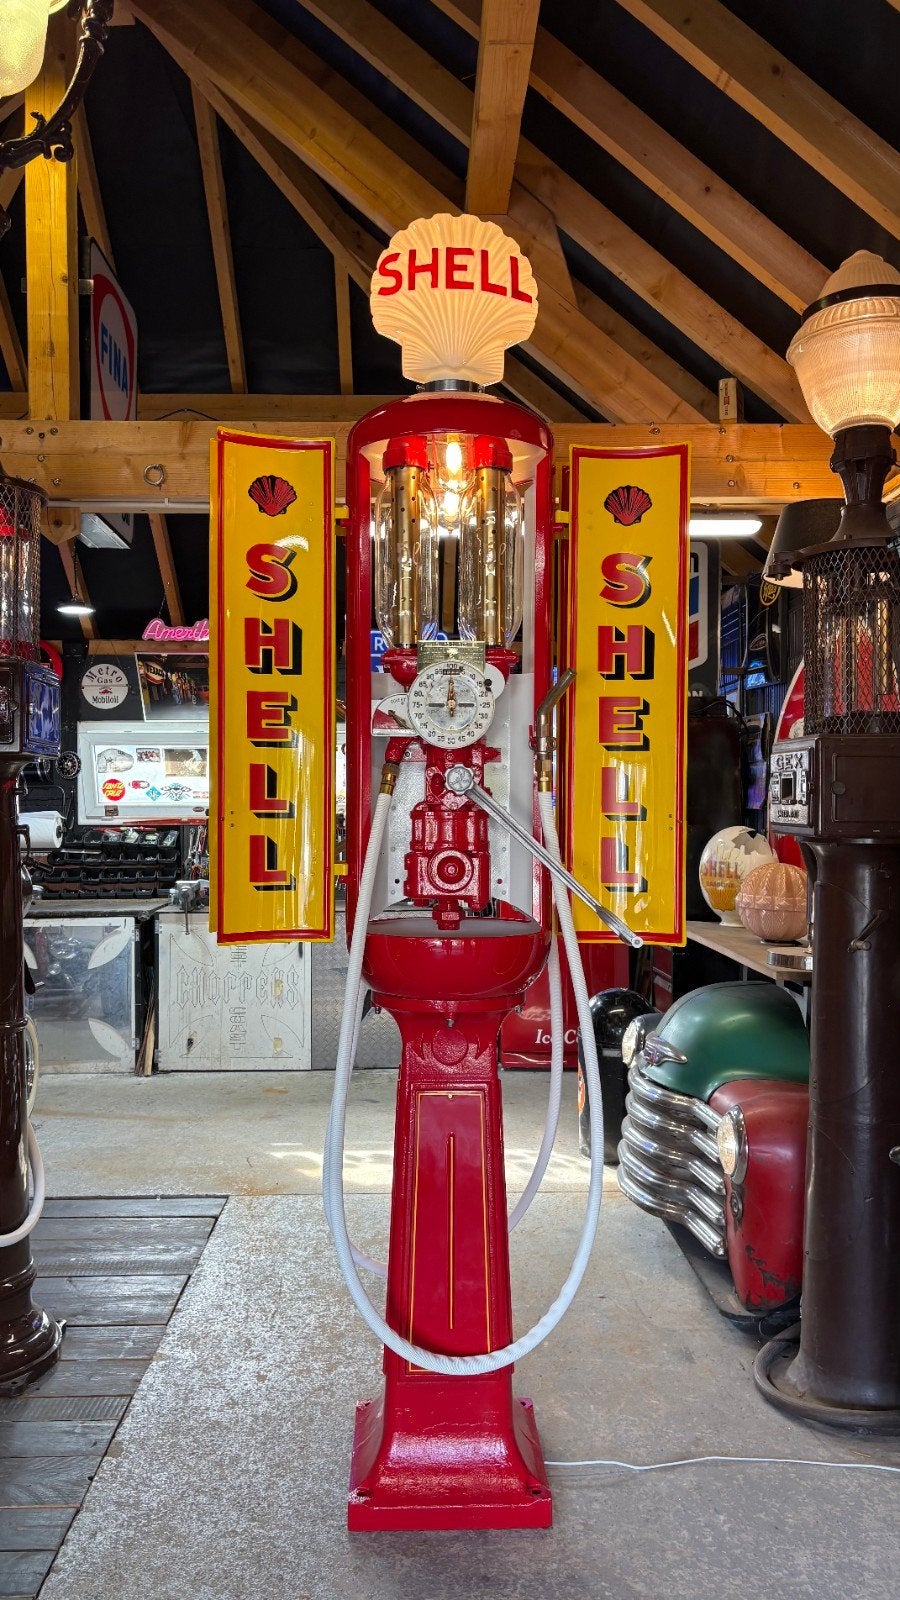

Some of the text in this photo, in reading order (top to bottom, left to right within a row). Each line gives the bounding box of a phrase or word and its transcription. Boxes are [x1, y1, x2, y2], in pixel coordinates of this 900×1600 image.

[378, 247, 532, 304] SHELL
[101, 322, 128, 399] FINA
[85, 666, 123, 683] Metro
[245, 542, 302, 892] SHELL
[598, 552, 654, 892] SHELL
[776, 752, 803, 771] GEX
[103, 782, 125, 790] SANTA
[104, 789, 123, 798] CRUZ
